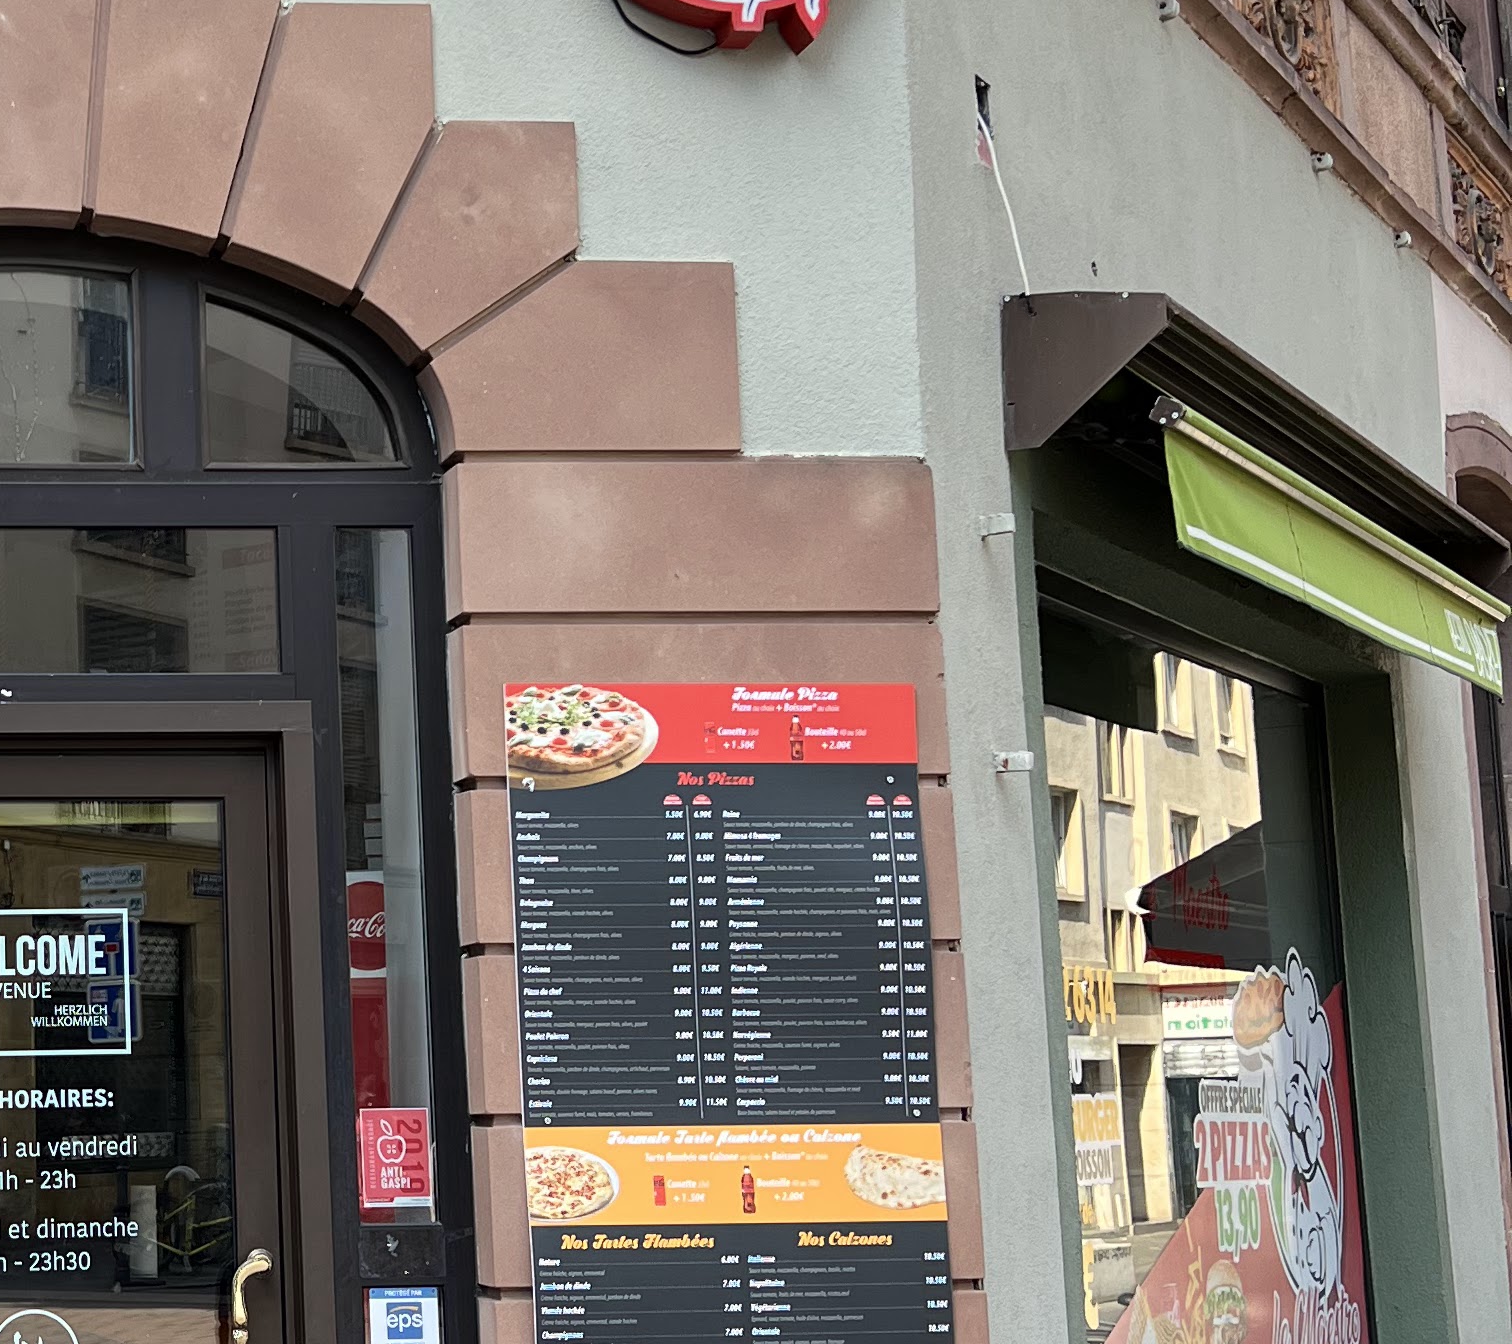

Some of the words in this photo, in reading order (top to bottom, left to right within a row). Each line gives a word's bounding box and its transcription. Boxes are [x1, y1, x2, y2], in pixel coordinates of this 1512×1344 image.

[732, 687, 794, 701] Formule
[797, 687, 838, 701] Pizza
[677, 772, 704, 787] Nos
[708, 772, 755, 787] Pizzas
[55, 1004, 108, 1016] HERZLICH
[31, 1015, 109, 1027] WILLKOMMEN
[0, 1089, 115, 1109] HORAIRES:
[803, 1129, 862, 1143] Calzone
[16, 1141, 40, 1157] au
[47, 1136, 138, 1158] vendredi
[1195, 1119, 1209, 1182] 2
[1209, 1120, 1272, 1182] PIZZAS
[40, 1170, 77, 1190] 23h
[381, 1177, 410, 1189] GASPI
[9, 1222, 29, 1240] et
[37, 1219, 139, 1239] dimanche
[1217, 1187, 1259, 1260] 13,90
[561, 1235, 588, 1250] Nos
[593, 1234, 638, 1250] Tartes
[643, 1234, 715, 1249] Flambées
[798, 1231, 825, 1247] Nos
[828, 1231, 893, 1246] Calzones
[29, 1252, 91, 1272] 23h30
[387, 1314, 423, 1332] eps
